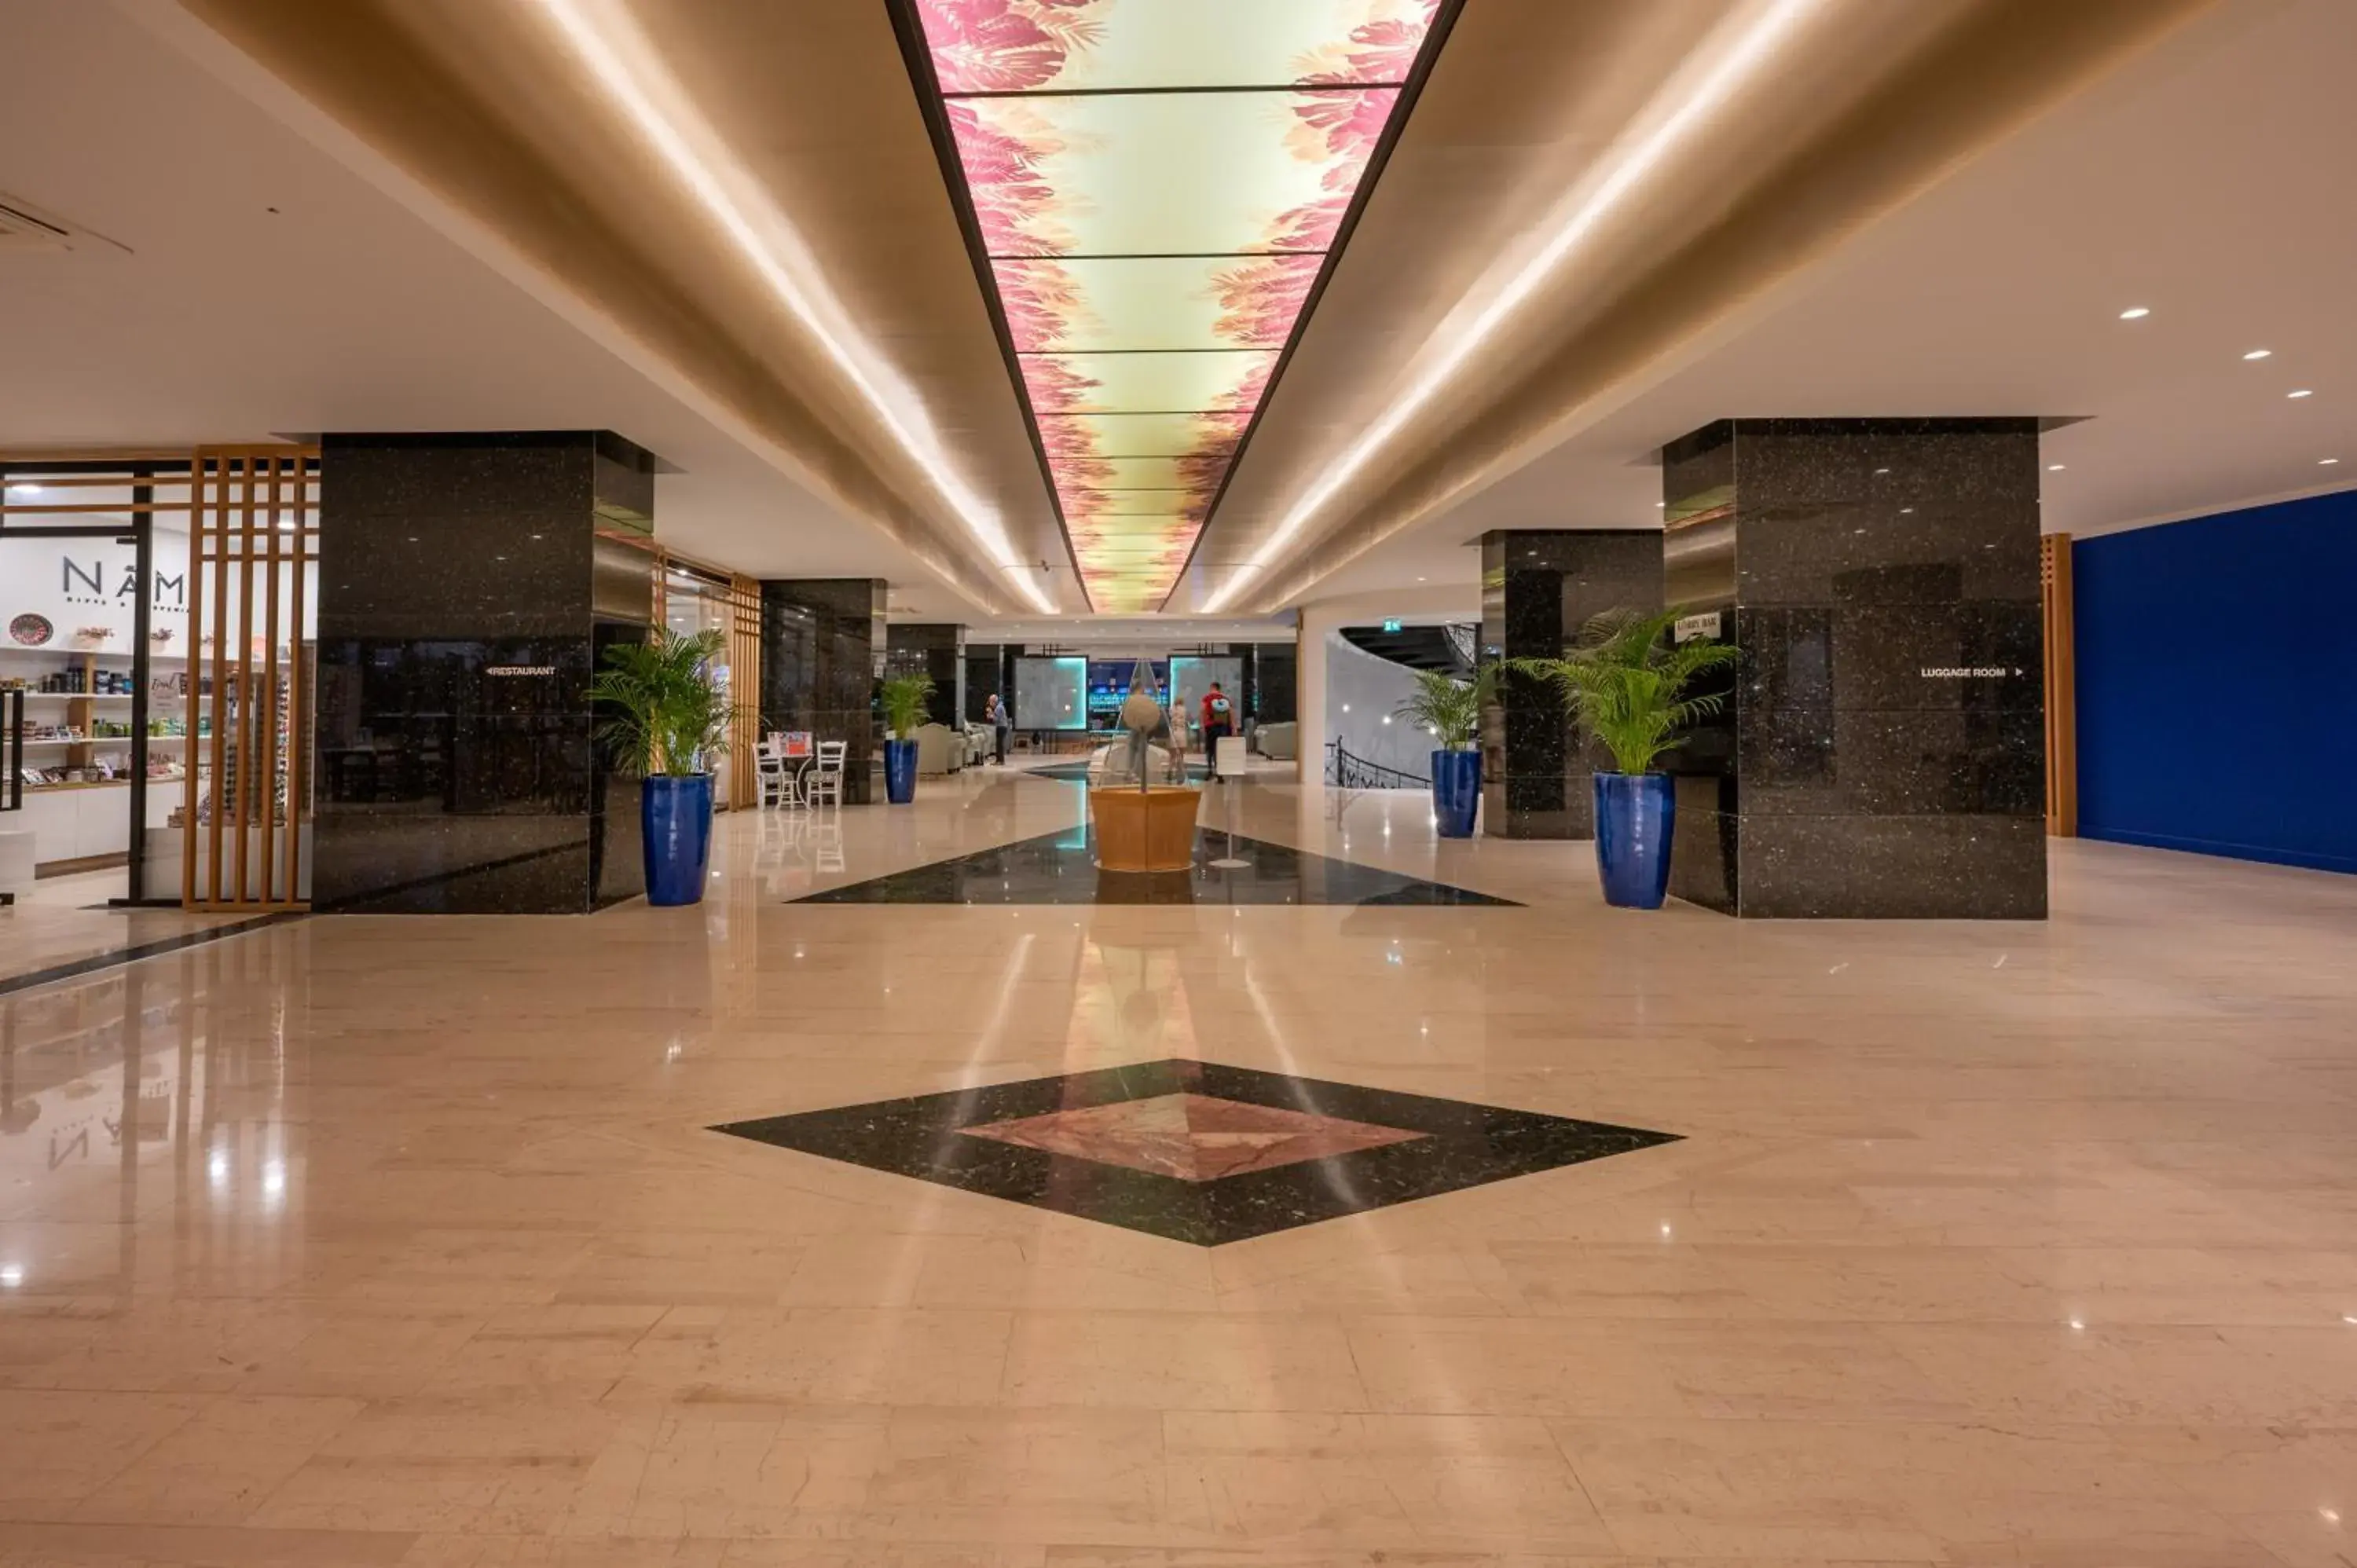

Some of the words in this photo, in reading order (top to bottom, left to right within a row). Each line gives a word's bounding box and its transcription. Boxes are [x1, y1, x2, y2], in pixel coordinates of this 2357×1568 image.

[493, 666, 556, 676] RESTAURANT
[1921, 668, 1971, 677] LUGGAGE
[1973, 668, 2006, 677] ROOM
